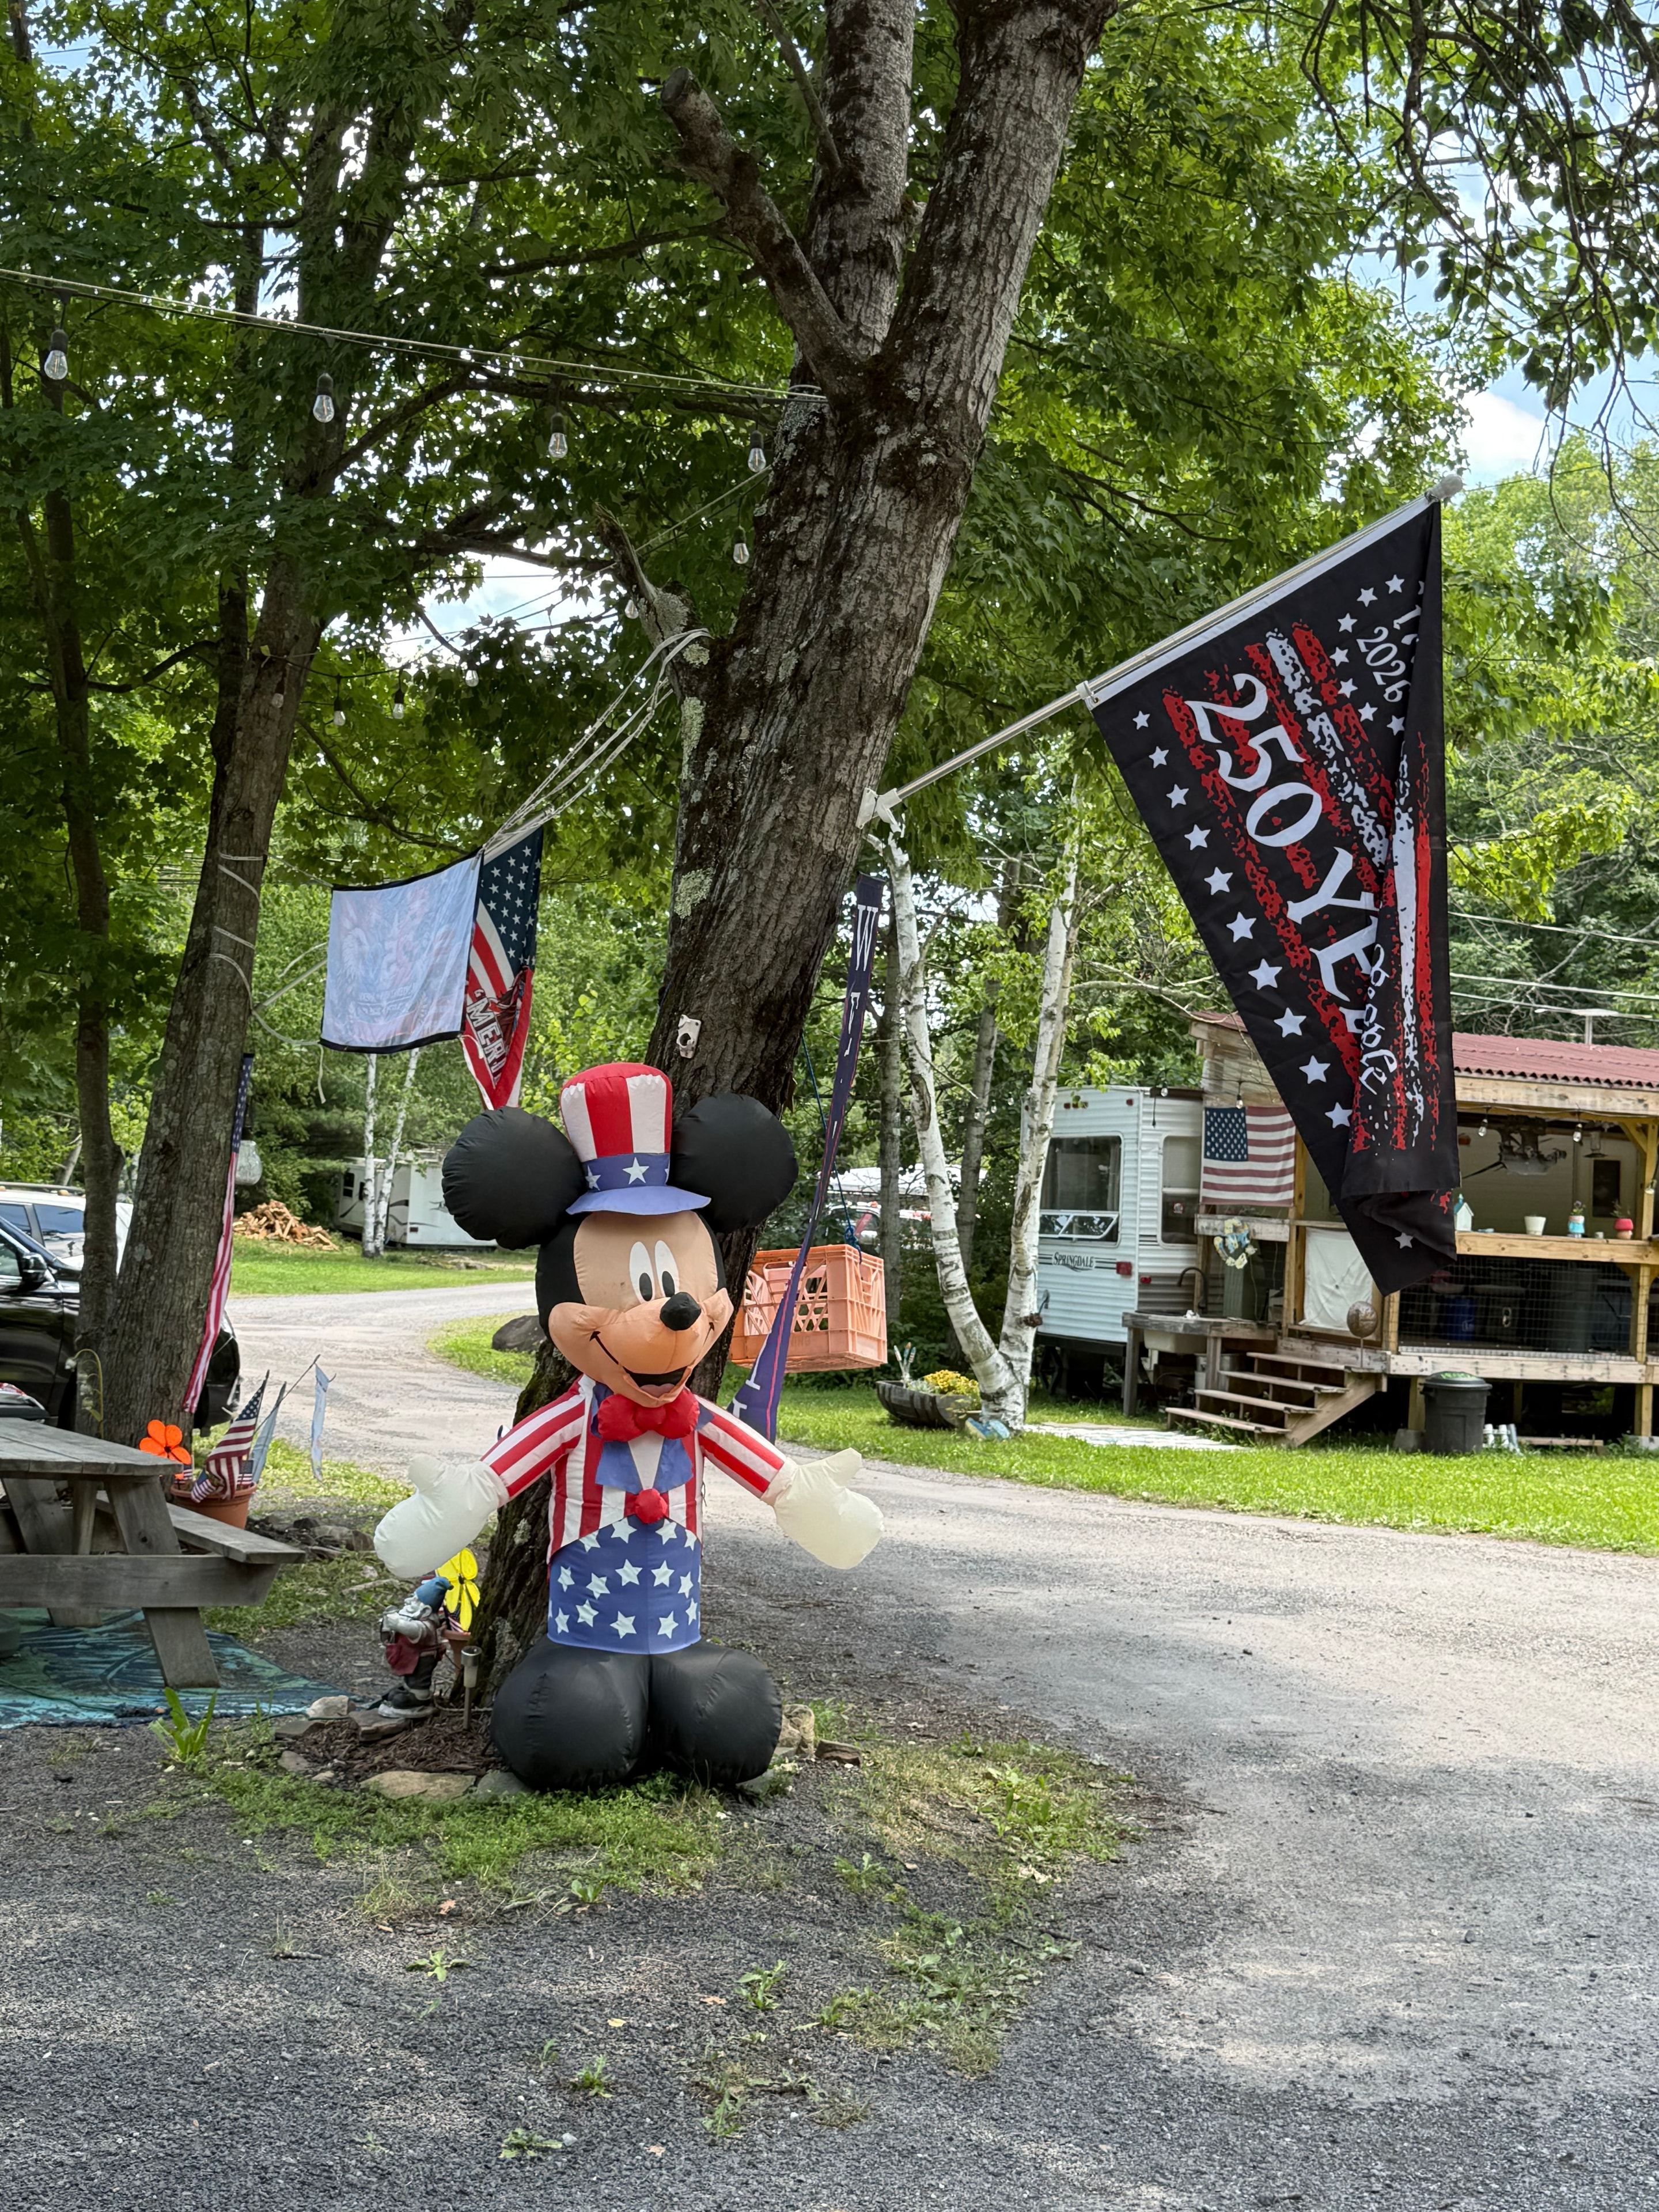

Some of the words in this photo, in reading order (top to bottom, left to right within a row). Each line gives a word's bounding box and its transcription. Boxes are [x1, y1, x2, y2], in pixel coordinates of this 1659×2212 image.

[1356, 626, 1411, 702] 2026
[1185, 673, 1321, 847] 250
[1054, 1252, 1094, 1267] SPRINGDALE
